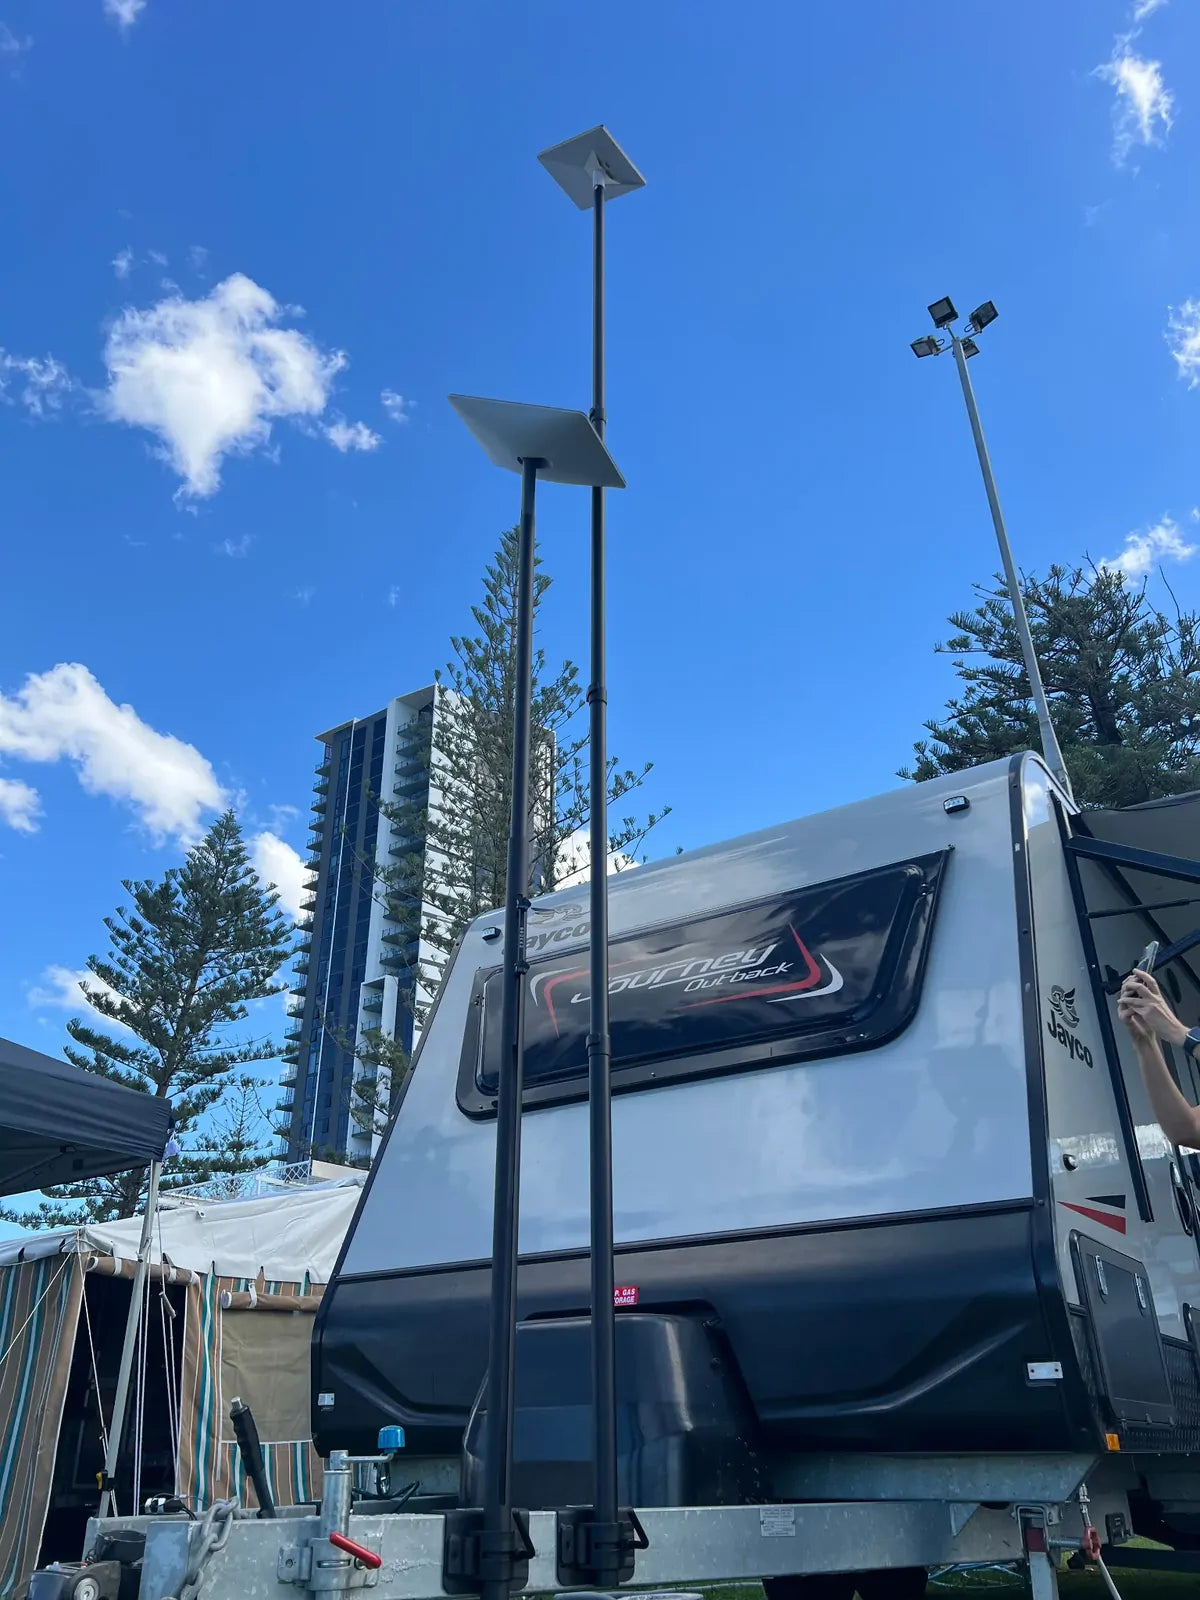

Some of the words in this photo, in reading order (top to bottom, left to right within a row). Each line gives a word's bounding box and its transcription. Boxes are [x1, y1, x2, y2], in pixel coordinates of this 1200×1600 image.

[502, 922, 591, 954] ayco
[684, 961, 794, 992] Outback
[1047, 1009, 1093, 1069] Jayco
[614, 1296, 635, 1304] ORAGE
[622, 1288, 636, 1296] GAS
